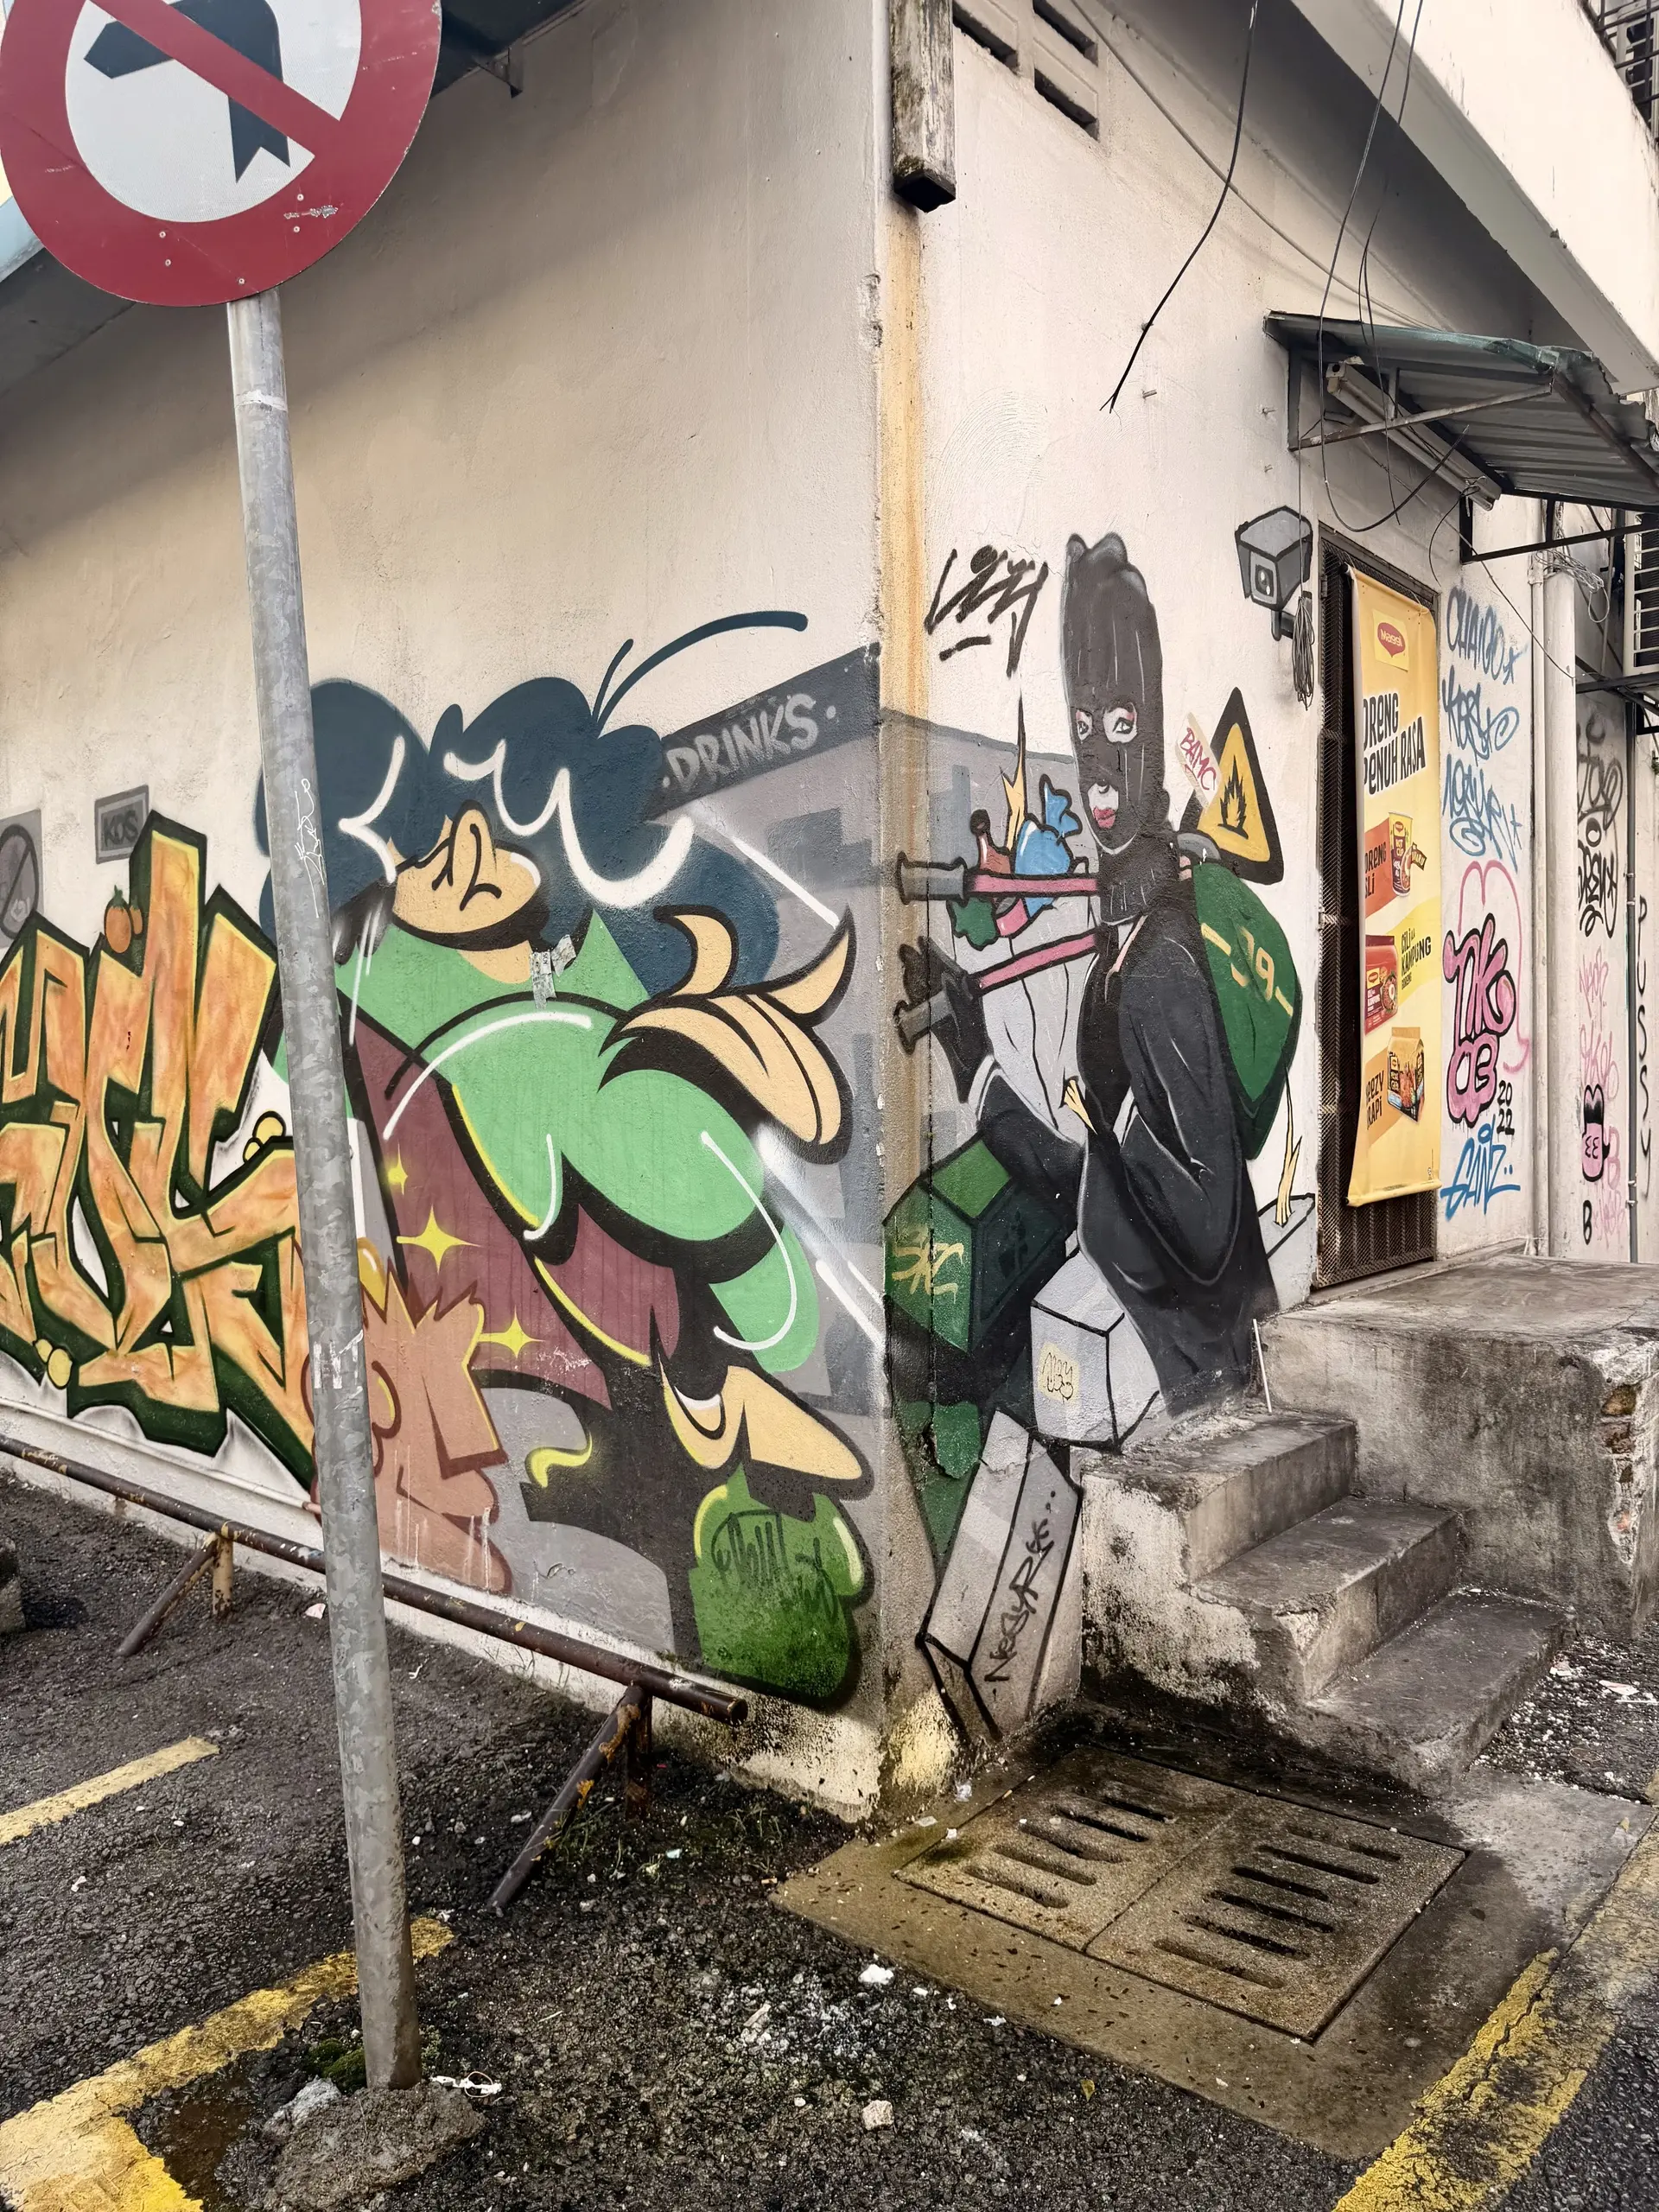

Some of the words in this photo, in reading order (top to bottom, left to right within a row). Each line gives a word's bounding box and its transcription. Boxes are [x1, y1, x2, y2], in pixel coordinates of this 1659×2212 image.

[1380, 627, 1403, 648] Maggi
[666, 693, 819, 792] DRINKS
[1401, 716, 1427, 780] RASA
[1637, 894, 1651, 1198] PUSSY
[1498, 1080, 1513, 1106] 20
[1497, 1107, 1515, 1136] 22
